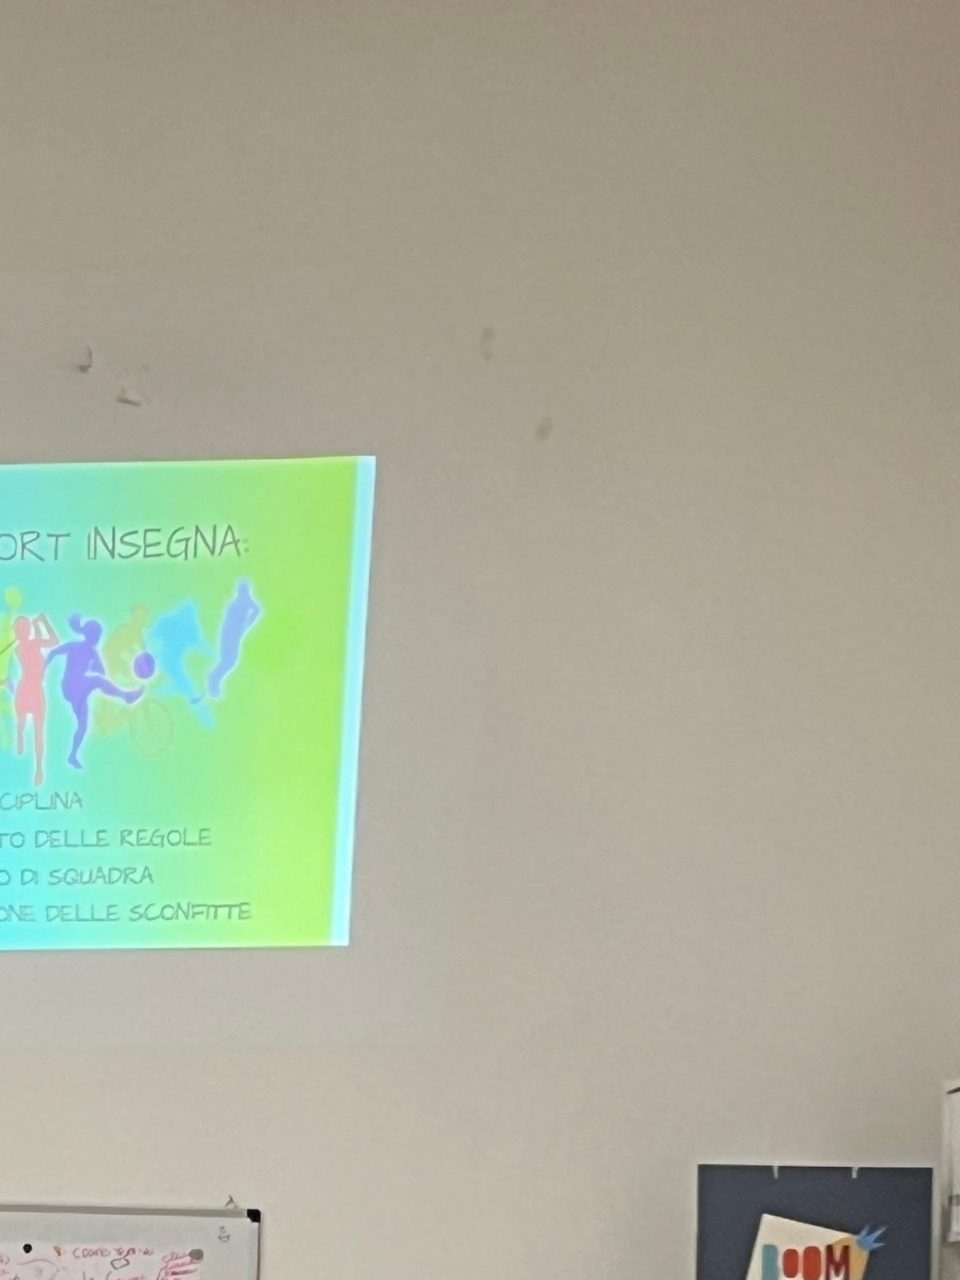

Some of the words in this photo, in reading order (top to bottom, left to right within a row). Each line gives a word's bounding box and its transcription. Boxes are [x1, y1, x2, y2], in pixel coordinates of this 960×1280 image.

[35, 829, 110, 848] DELLE
[120, 828, 212, 847] REGOLE
[21, 869, 39, 886] DI
[48, 866, 154, 886] SQUADRA
[46, 903, 120, 922] DELLE
[128, 901, 253, 921] SCONFITTE
